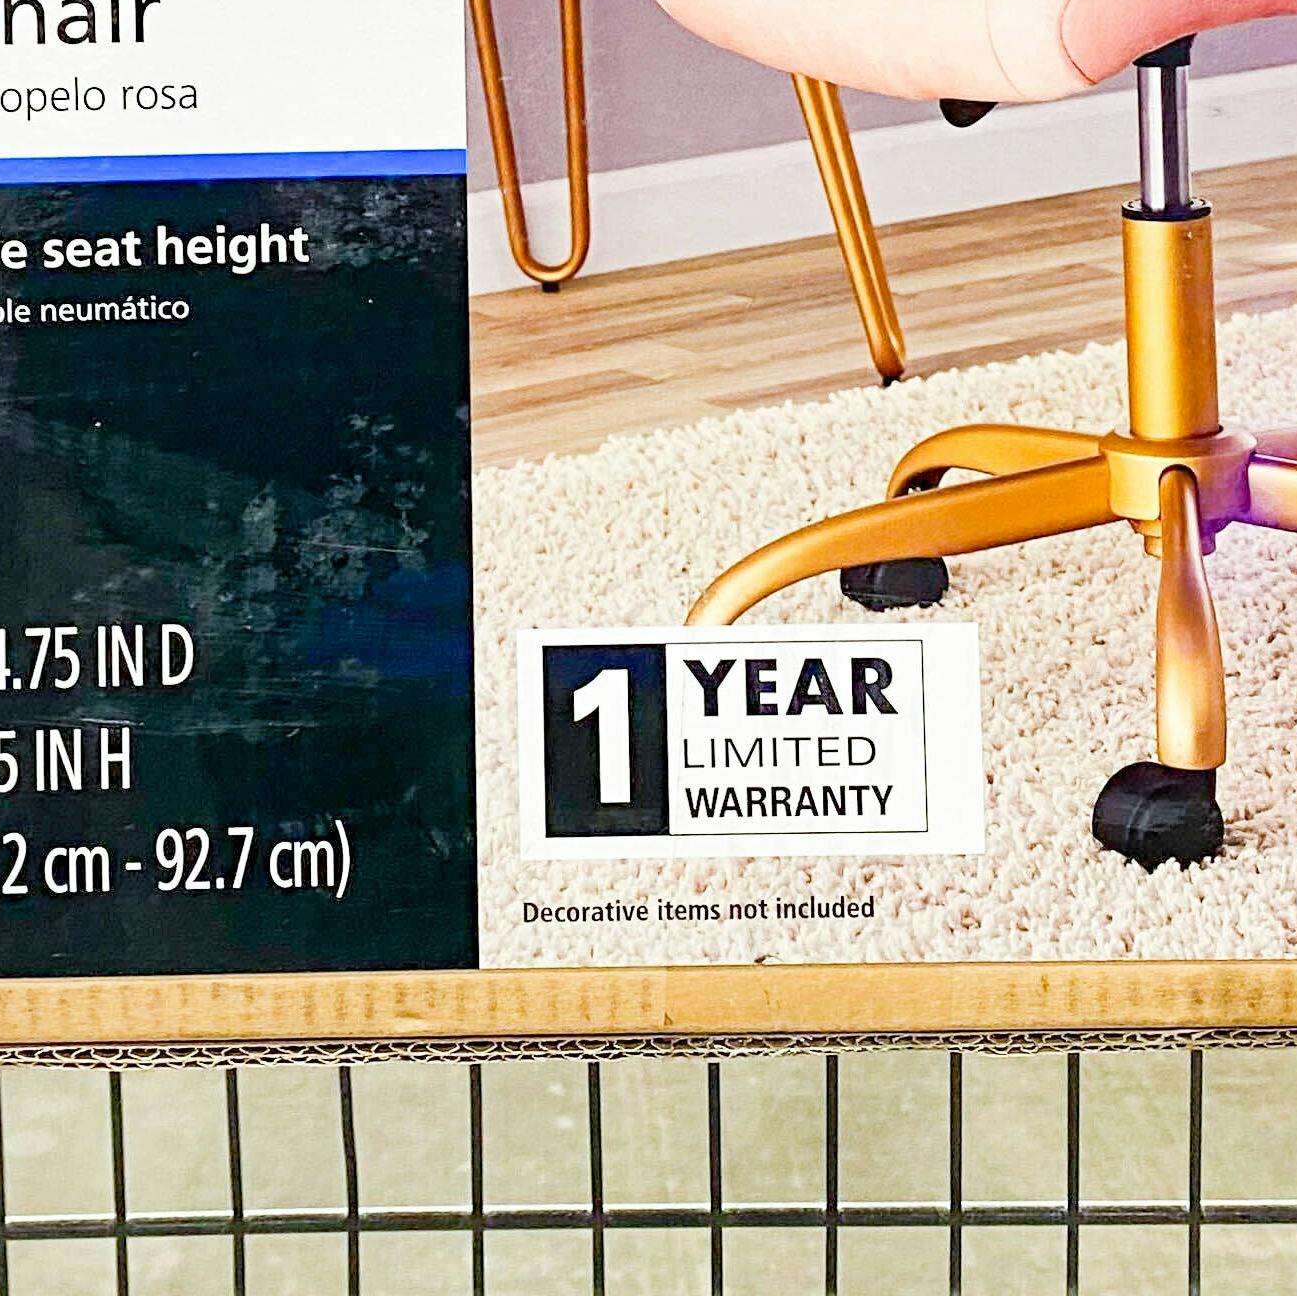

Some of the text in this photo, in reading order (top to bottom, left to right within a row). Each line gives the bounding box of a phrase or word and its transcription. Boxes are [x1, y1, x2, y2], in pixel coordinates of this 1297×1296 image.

[122, 84, 198, 111] rosa
[43, 231, 142, 269] seat
[157, 223, 310, 275] height
[40, 295, 190, 322] neumático
[97, 624, 144, 688] IN
[161, 623, 194, 686] D
[682, 657, 899, 717] YEAR
[35, 729, 82, 792] IN
[100, 727, 130, 790] H
[573, 668, 631, 804] 1
[683, 736, 877, 769] LIMITED
[684, 784, 894, 819] WARRANTY
[44, 846, 110, 894] cm
[155, 826, 254, 891] 92.7
[269, 819, 351, 899] cm)
[523, 895, 875, 923] Decorative items not included
